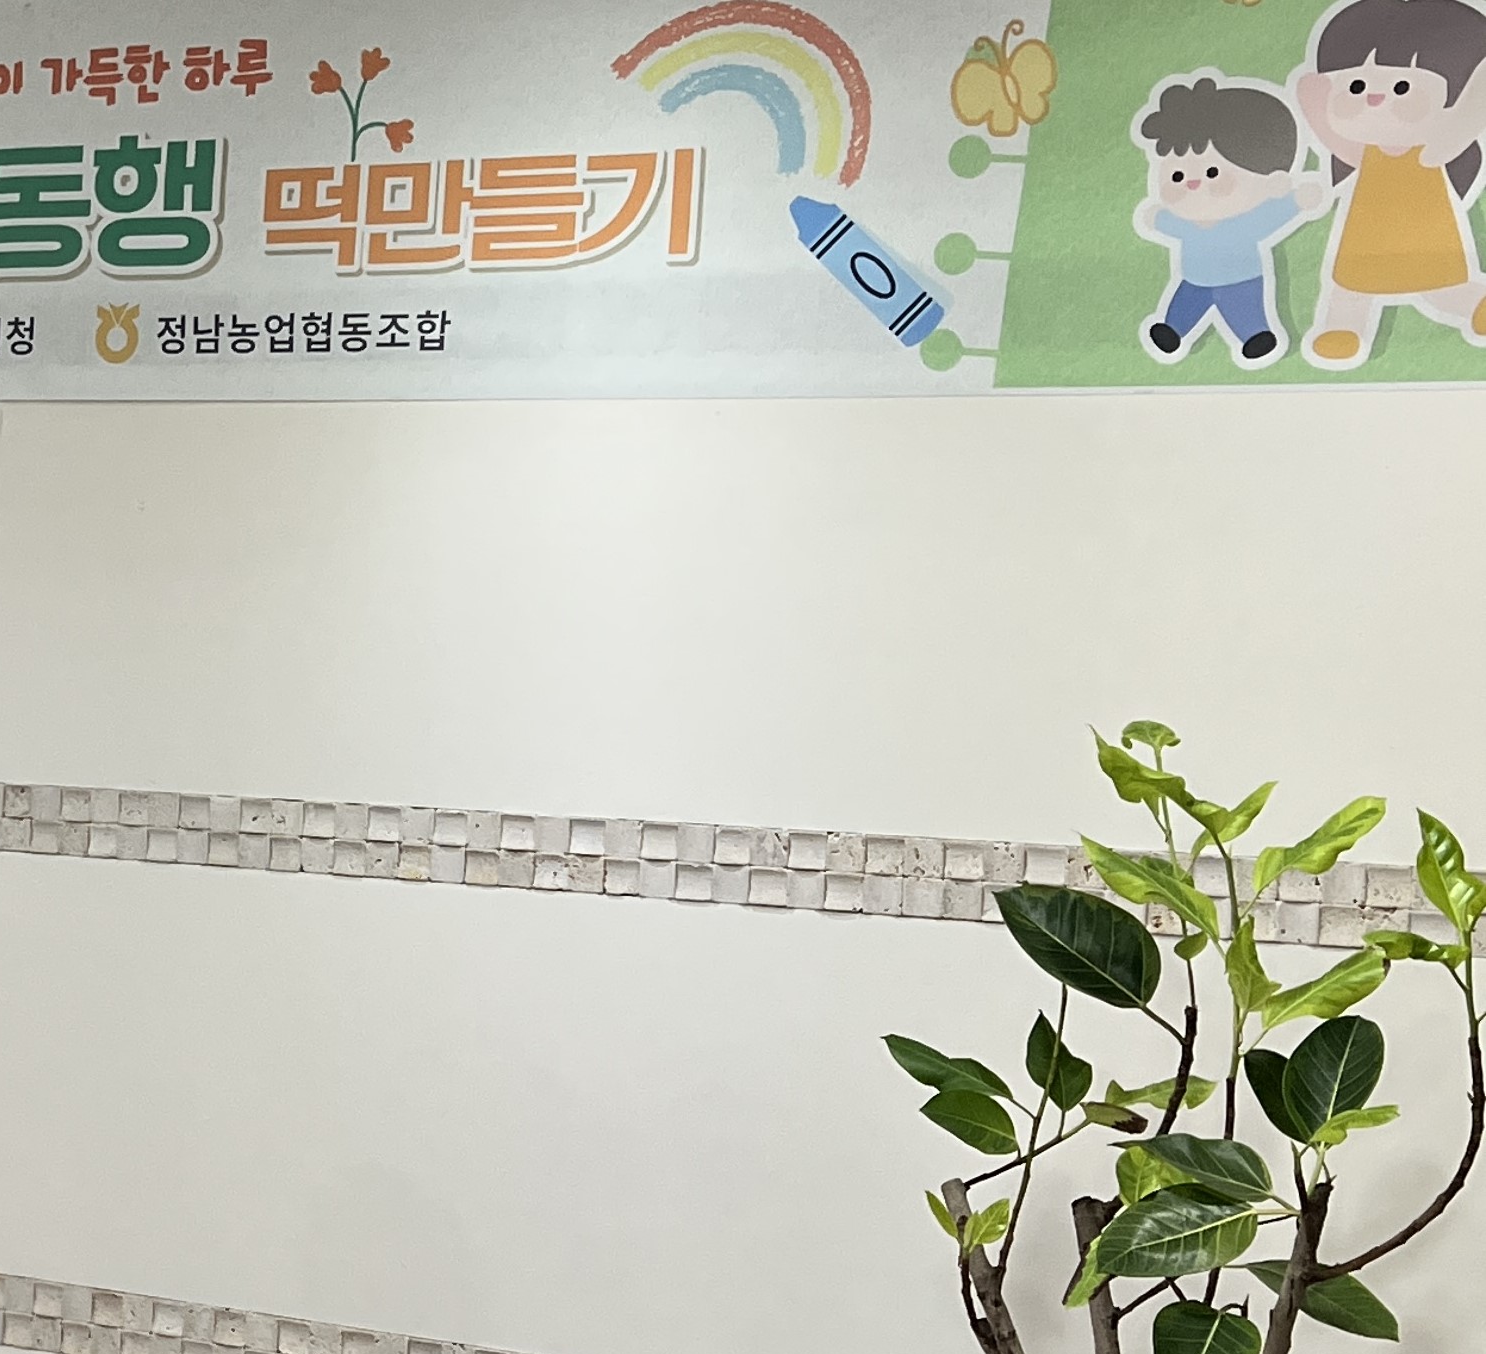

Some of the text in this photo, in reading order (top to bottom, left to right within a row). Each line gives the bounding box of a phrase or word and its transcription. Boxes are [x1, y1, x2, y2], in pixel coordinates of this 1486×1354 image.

[41, 44, 171, 105] 가득한
[183, 38, 274, 97] 하루
[262, 147, 696, 267] 떡만들기
[156, 310, 452, 355] 정남농업협동조합
